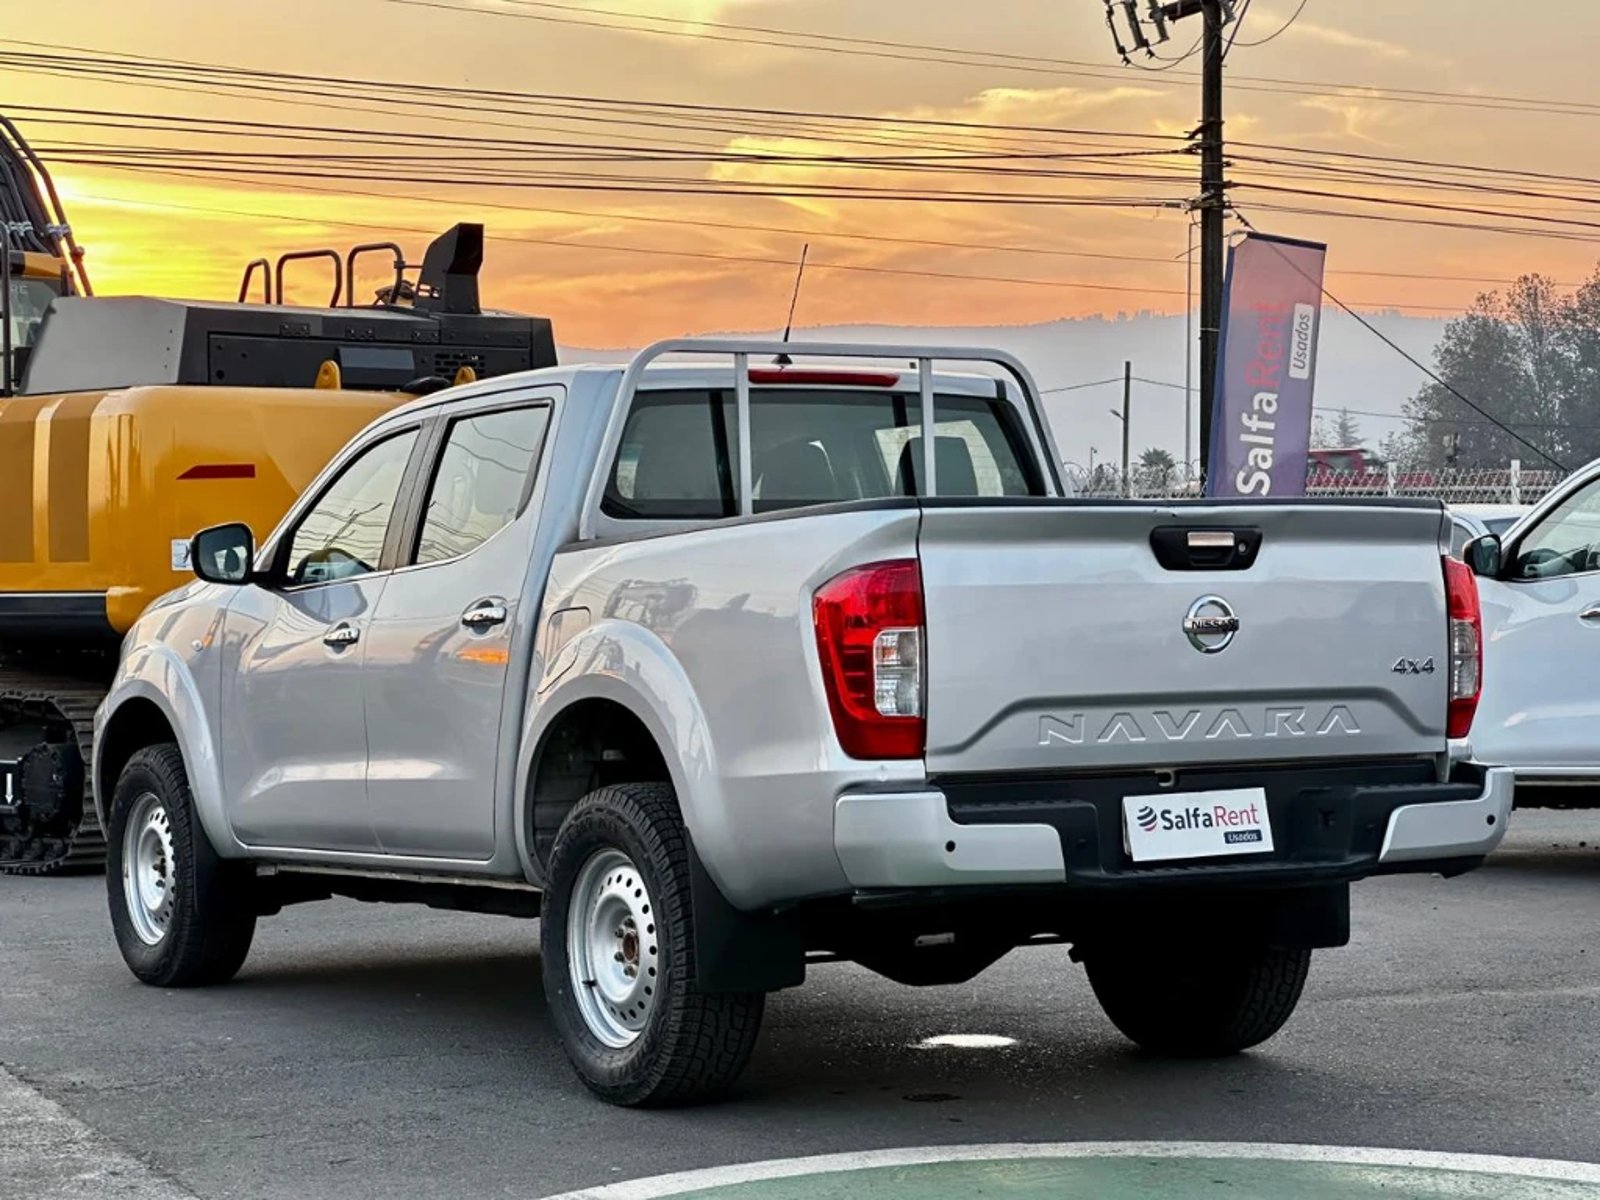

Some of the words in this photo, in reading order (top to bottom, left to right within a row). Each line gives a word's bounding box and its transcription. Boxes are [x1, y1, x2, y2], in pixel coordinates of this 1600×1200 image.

[1293, 313, 1310, 370] Usados
[1236, 303, 1290, 497] SalfaRent
[1191, 619, 1236, 630] NISSAN
[1038, 705, 1362, 745] NAVARA
[1160, 803, 1260, 831] SalfaRent
[1228, 832, 1258, 842] Usados
